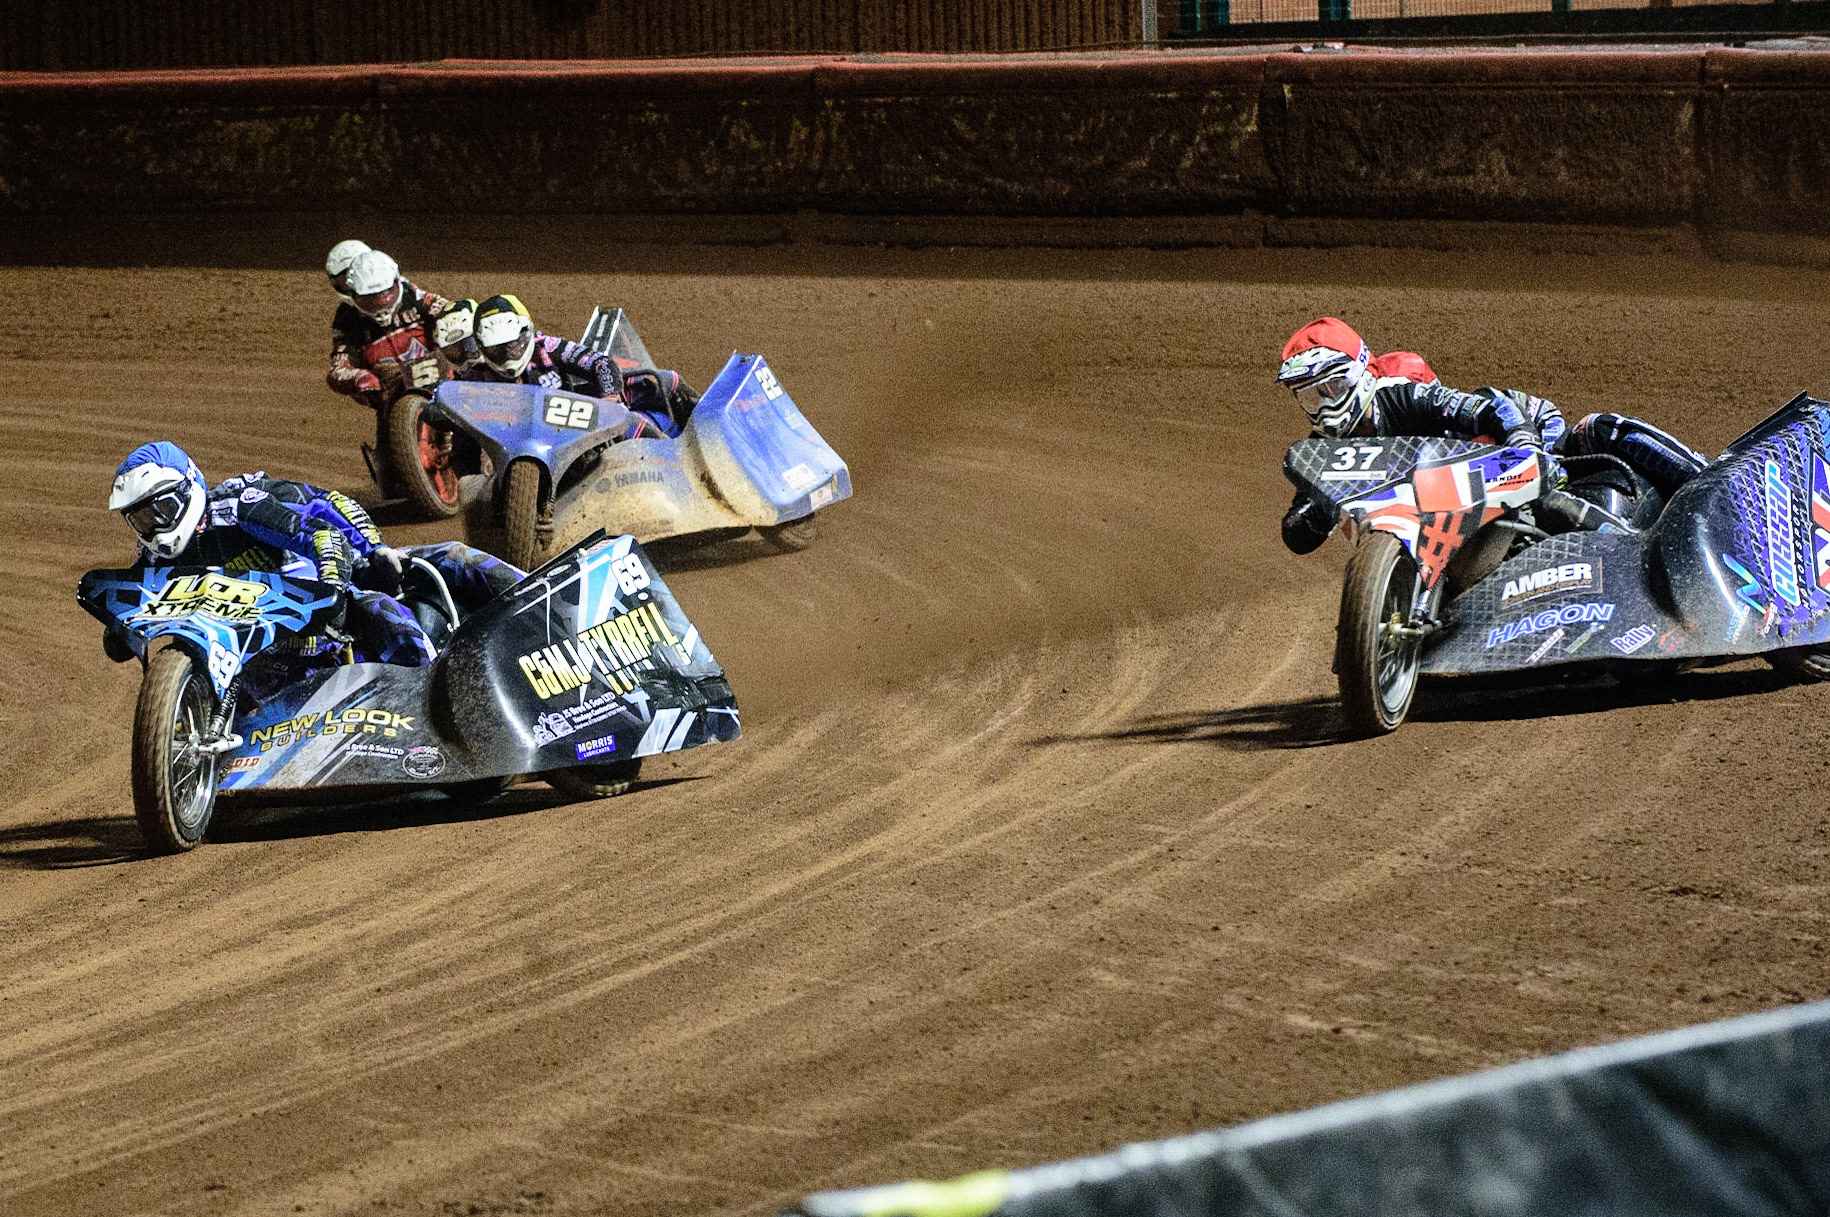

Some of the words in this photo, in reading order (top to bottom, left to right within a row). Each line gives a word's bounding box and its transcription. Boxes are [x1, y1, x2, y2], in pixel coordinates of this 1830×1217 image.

[412, 358, 440, 388] 5
[754, 366, 784, 401] 22
[545, 396, 594, 429] 22
[1330, 446, 1384, 471] 37
[614, 471, 665, 488] YAMAHA
[610, 552, 651, 597] 69
[1501, 562, 1592, 601] AMBER
[145, 594, 265, 620] XTREME
[1484, 602, 1616, 650] HAGON
[1613, 625, 1654, 651] Rally
[207, 640, 240, 689] 69
[590, 696, 605, 707] Son
[601, 691, 616, 703] LTD
[250, 712, 320, 746] NEW
[323, 708, 416, 731] LOOK
[260, 724, 399, 752] BUILDERS
[375, 744, 390, 753] Son
[390, 747, 405, 755] LTD
[577, 735, 613, 752] MORRIS
